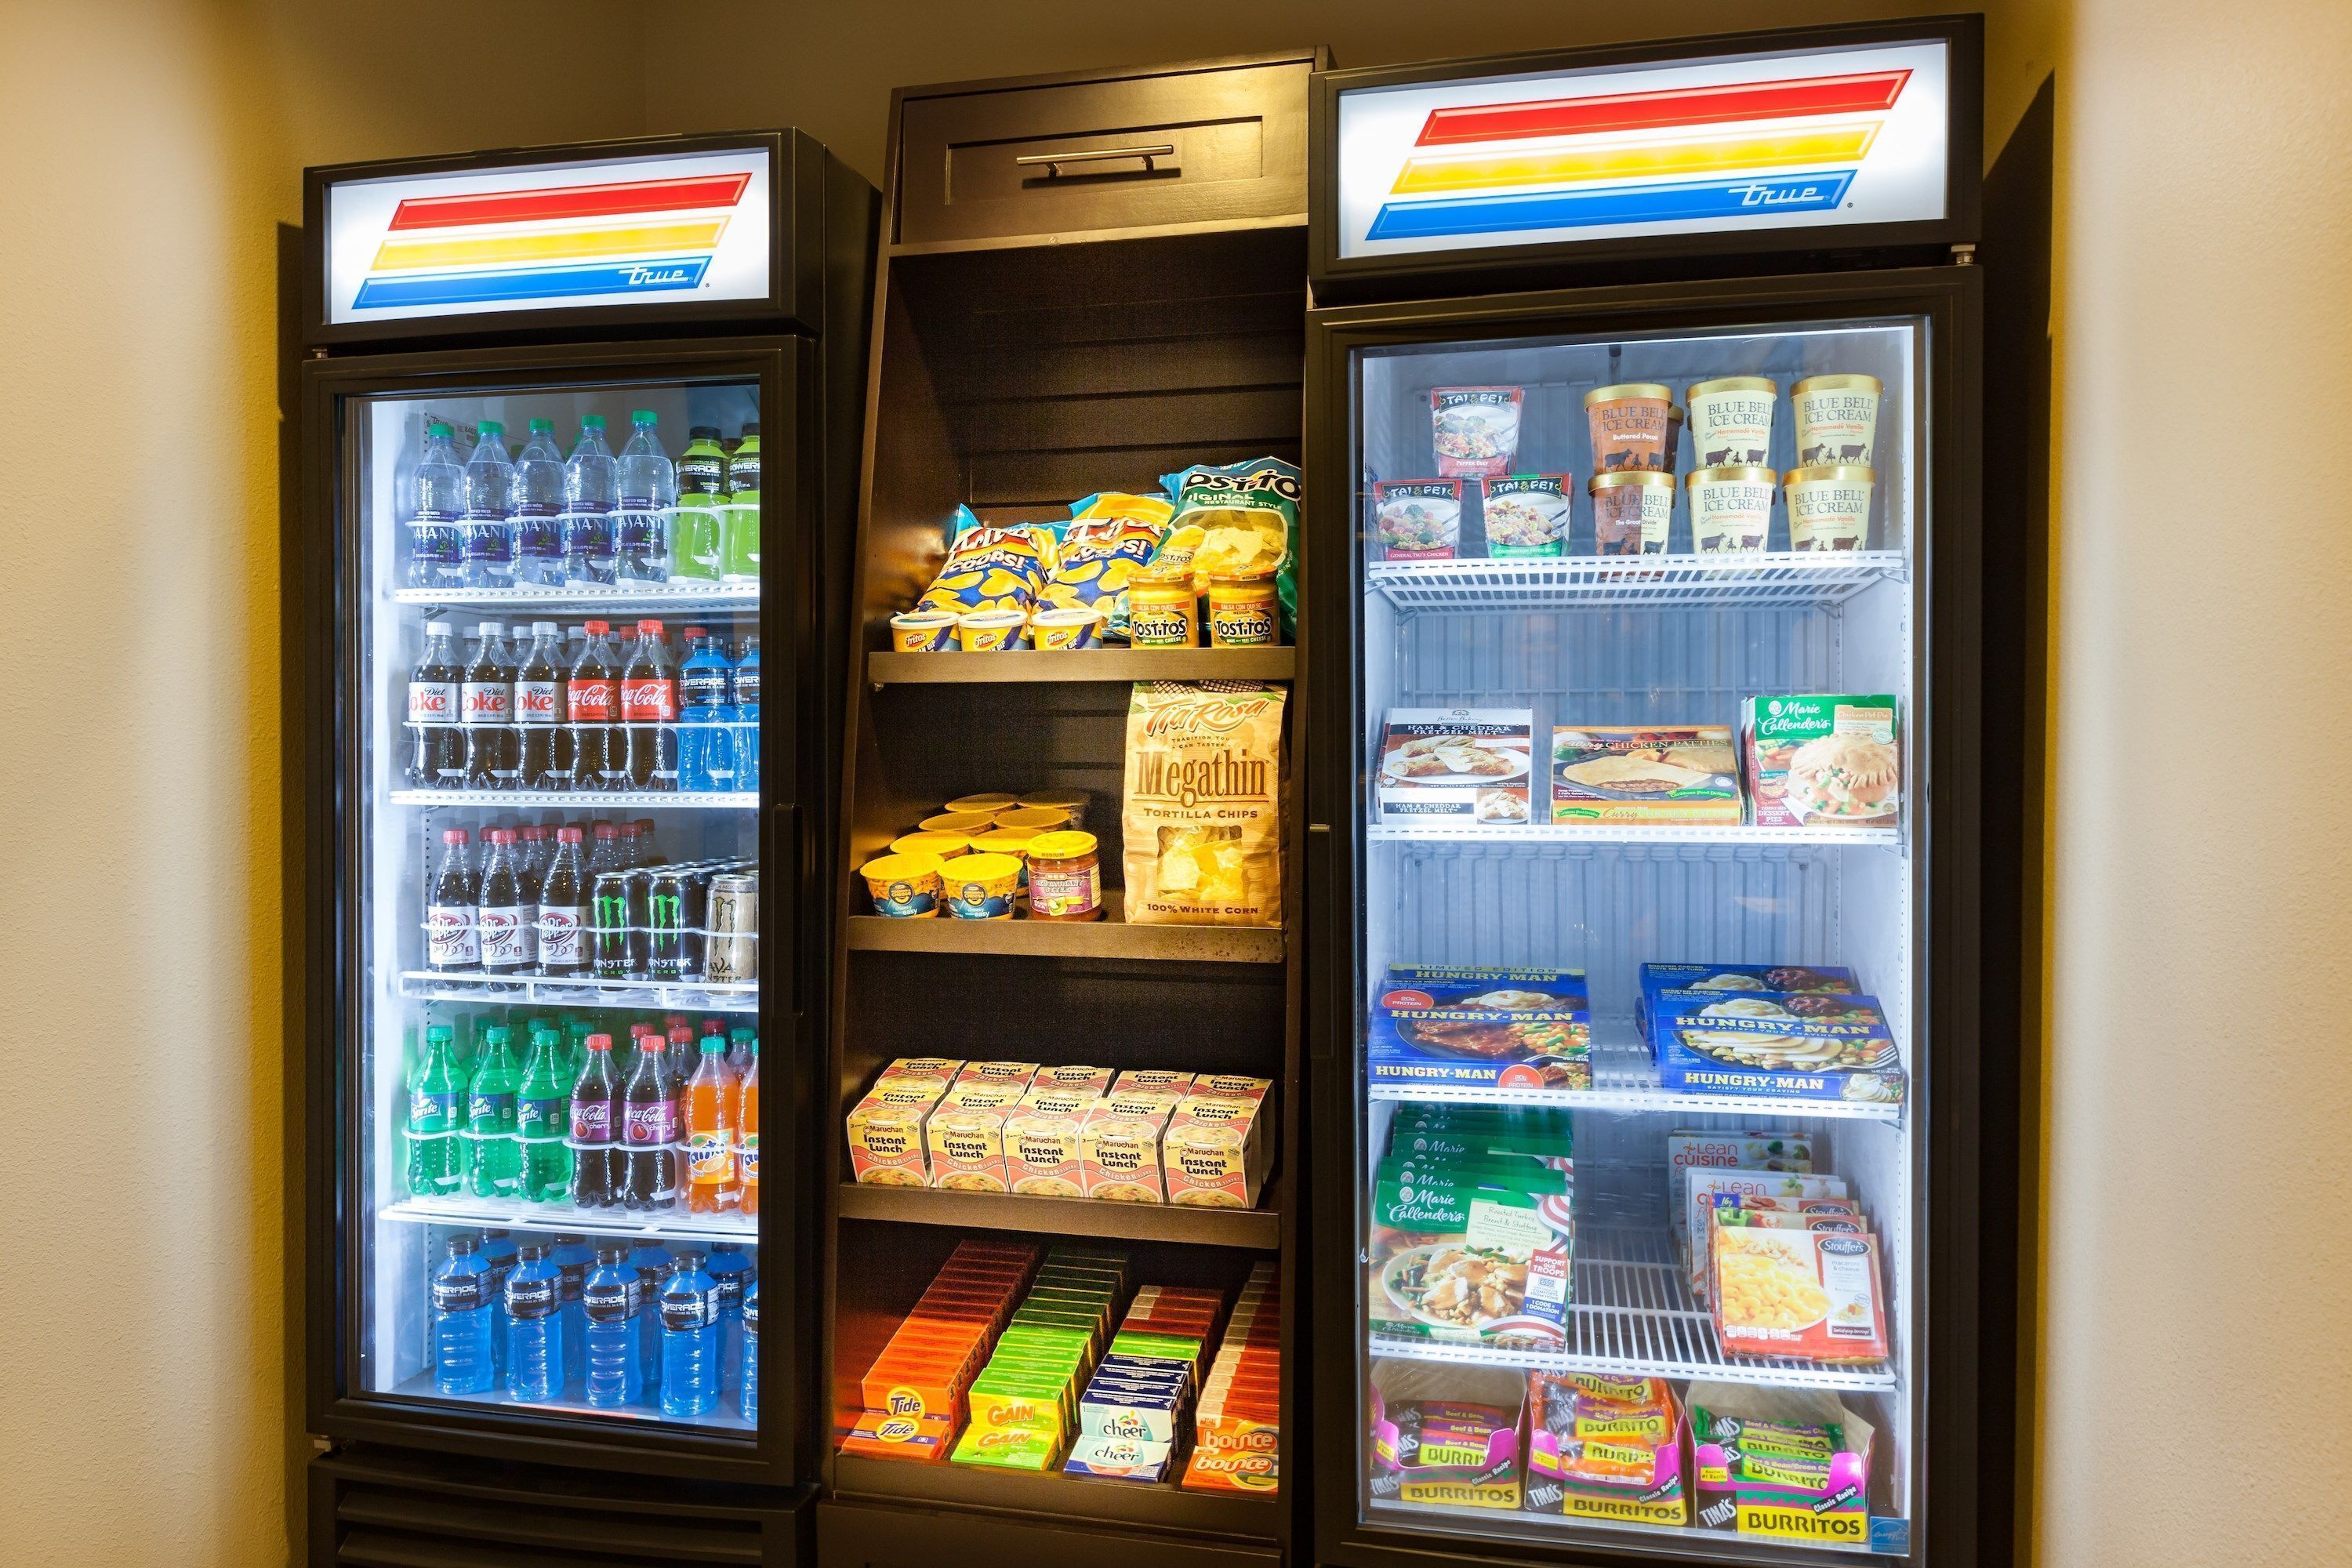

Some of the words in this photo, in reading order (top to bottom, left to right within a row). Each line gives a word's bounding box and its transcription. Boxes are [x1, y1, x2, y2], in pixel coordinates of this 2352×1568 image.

[1728, 184, 1824, 206] true
[619, 265, 688, 285] true
[1708, 401, 1744, 416] BLUE
[1749, 401, 1770, 414] BELL
[1804, 397, 1838, 411] BLUE
[1844, 397, 1872, 409] BELL
[1602, 406, 1636, 420] BLUE
[1641, 406, 1665, 419] BELL
[1709, 415, 1730, 427] ICE
[1733, 413, 1769, 426] CREAM
[1805, 412, 1823, 424] ICE
[1827, 409, 1871, 422] CREAM
[1603, 419, 1622, 432] ICE
[1625, 418, 1664, 430] CREAM
[1391, 487, 1412, 498] TAI
[1423, 485, 1446, 495] PEI
[1497, 481, 1518, 492] TAI
[1530, 480, 1553, 491] PEI
[1704, 487, 1740, 499] BLUE
[1744, 487, 1768, 499] BELL
[1606, 494, 1641, 507] BLUE
[1646, 494, 1669, 506] BELL
[1795, 490, 1829, 505] BLUE
[1834, 489, 1863, 502] BELL
[1258, 501, 1283, 511] STYLE
[1704, 501, 1724, 512] ICE
[1728, 499, 1767, 511] CREAM
[1796, 504, 1813, 517] ICE
[1817, 503, 1863, 514] CREAM
[1607, 508, 1624, 518] ICE
[1627, 507, 1668, 519] CREAM
[1133, 618, 1186, 637] TOSTITOS
[1216, 617, 1272, 637] TOSTITOS
[906, 633, 926, 645] Fritos
[974, 633, 997, 645] Fritos
[1047, 632, 1069, 643] Fritos
[424, 687, 445, 695] Diet
[484, 687, 505, 695] Diet
[532, 686, 554, 695] Diet
[1144, 699, 1196, 736] Tia
[1189, 698, 1269, 732] Rosa
[1780, 702, 1820, 720] Marie
[1758, 717, 1831, 735] Callender's
[1134, 749, 1267, 808] Megathin
[1144, 808, 1211, 819] TORTILLA
[1217, 810, 1258, 819] CHIPS
[1147, 903, 1178, 914] 100%
[1180, 906, 1220, 914] WHITE
[1225, 906, 1259, 915] CORN
[1415, 970, 1558, 982] HUNGRY-MAN
[1390, 1009, 1573, 1021] HUNGRY-MAN
[1675, 1017, 1869, 1035] HUNGRY-MAN
[1375, 1065, 1496, 1080] HUNGRY-MAN
[1685, 1073, 1824, 1090] HUNGRY-MAN
[649, 1123, 671, 1133] cherry
[864, 1134, 906, 1145] Instant
[950, 1131, 985, 1140] Maruchan
[1026, 1136, 1062, 1145] Maruchan
[869, 1144, 903, 1153] Lunch
[943, 1140, 988, 1151] Instant
[1019, 1145, 1064, 1156] Instant
[1102, 1140, 1139, 1149] Maruchan
[1696, 1142, 1738, 1156] Lean
[949, 1149, 985, 1160] Lunch
[1096, 1149, 1142, 1160] Instant
[1187, 1148, 1225, 1157] Maruchan
[1025, 1155, 1061, 1165] Lunch
[1102, 1159, 1138, 1169] Lunch
[1180, 1157, 1228, 1168] Instant
[1186, 1167, 1223, 1176] Lunch
[1721, 1181, 1767, 1196] Lean
[1410, 1189, 1455, 1208] Marie
[1387, 1202, 1465, 1222] Callender's
[1489, 1207, 1513, 1217] Roasted
[1514, 1210, 1536, 1221] Turkey
[1824, 1240, 1864, 1253] Stouffer's
[1535, 1255, 1566, 1267] SUPPORT
[1534, 1265, 1565, 1277] TROOPS
[891, 1397, 921, 1415] Tide
[988, 1405, 1036, 1427] GAIN
[879, 1424, 916, 1436] Tide
[1104, 1418, 1146, 1439] cheer
[1584, 1419, 1659, 1433] BURRITO
[978, 1432, 1033, 1448] GAIN
[1205, 1430, 1273, 1450] bounce
[1094, 1446, 1140, 1461] cheer
[1196, 1456, 1270, 1472] bounce
[1472, 1472, 1492, 1486] Classic
[1491, 1459, 1512, 1475] Recipe
[1371, 1475, 1400, 1495] TINA'S
[1639, 1490, 1661, 1503] Classic
[1660, 1475, 1679, 1492] Recipe
[1411, 1487, 1515, 1503] BURRITOS
[1528, 1484, 1564, 1507] TINA'S
[1813, 1497, 1837, 1514] Classic
[1835, 1485, 1857, 1501] Recipe
[1573, 1499, 1681, 1520] BURRITOS
[1699, 1498, 1737, 1527] TINA'S
[1748, 1512, 1860, 1535] BURRITOS
